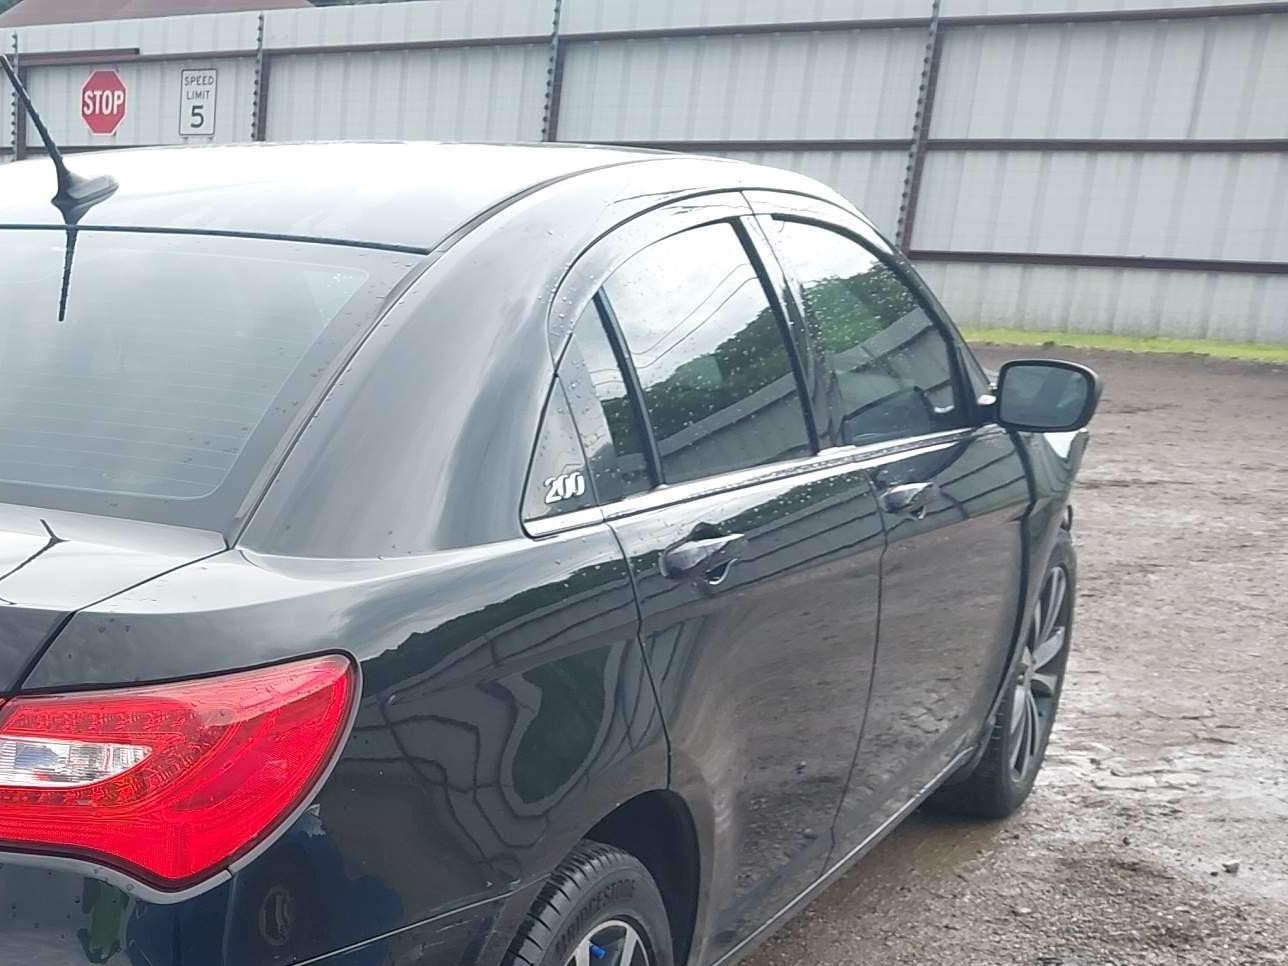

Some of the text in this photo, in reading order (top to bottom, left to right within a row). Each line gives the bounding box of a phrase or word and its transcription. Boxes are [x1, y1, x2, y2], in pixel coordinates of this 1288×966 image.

[184, 75, 214, 86] SPEED
[83, 90, 124, 115] STOP
[186, 90, 210, 100] LIMIT
[190, 105, 204, 128] 5
[544, 471, 585, 504] 200
